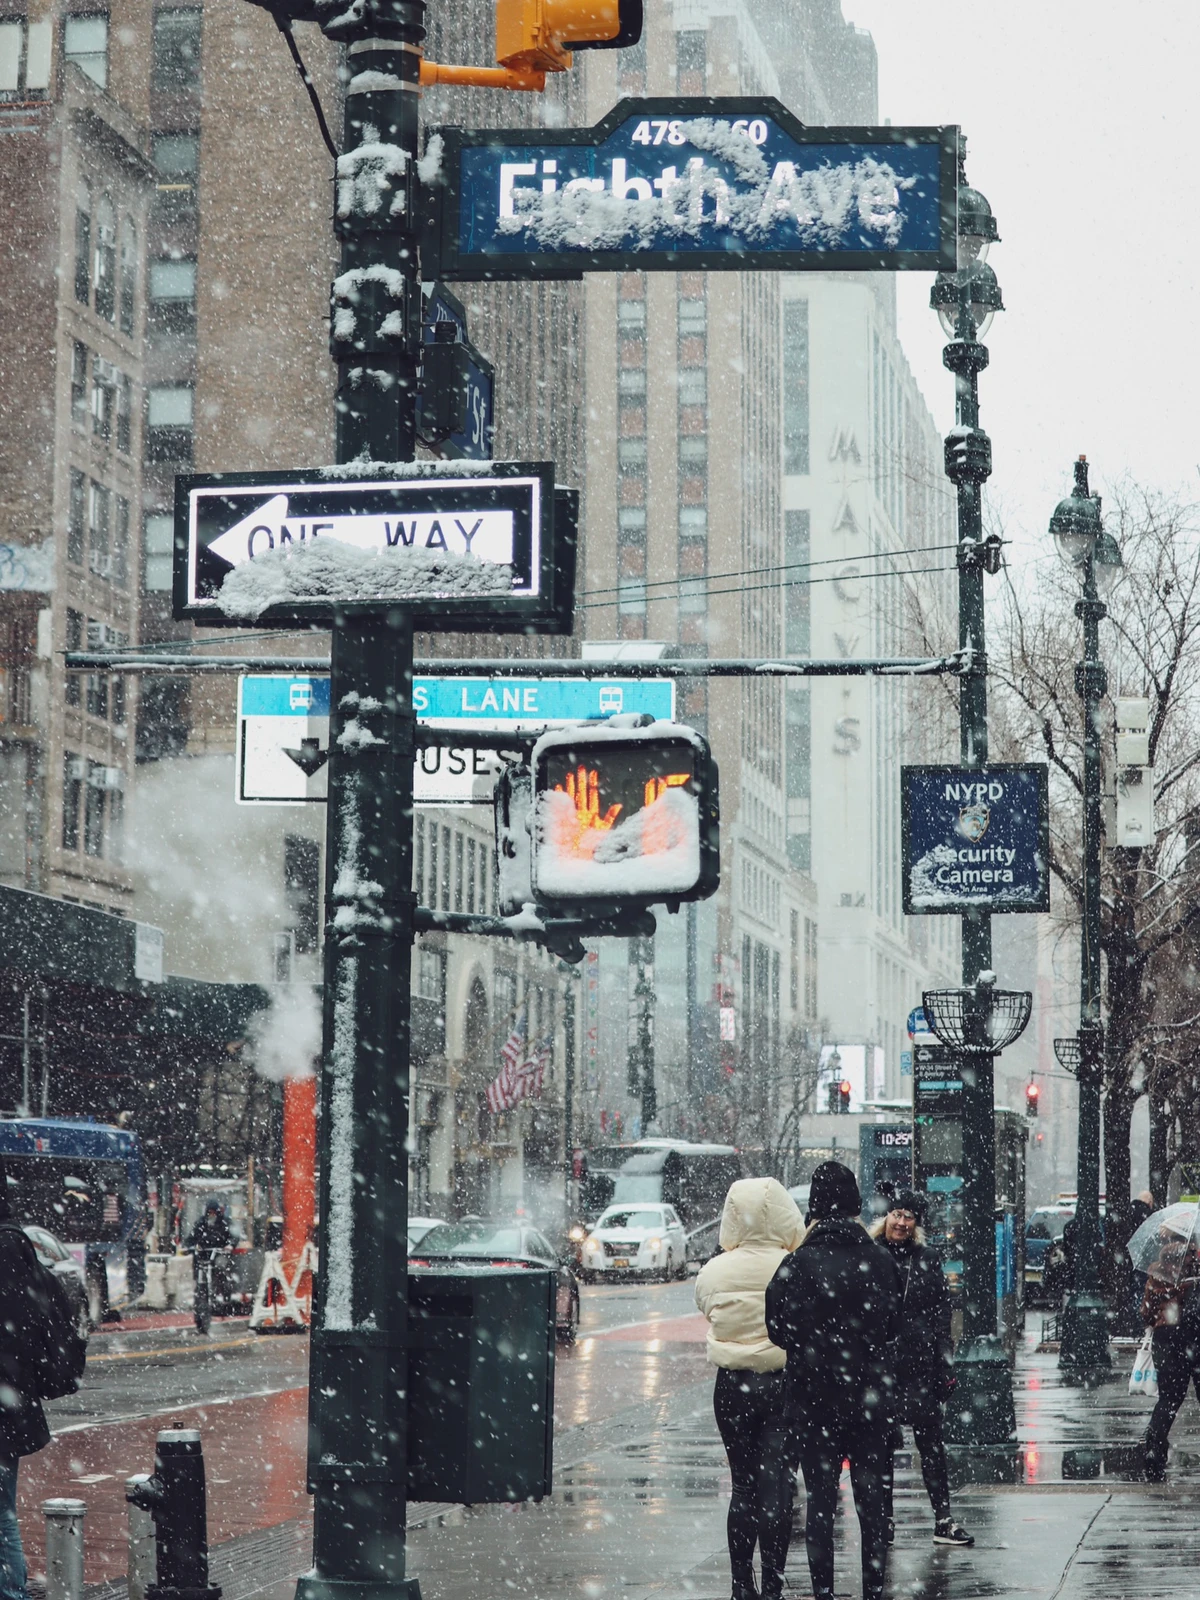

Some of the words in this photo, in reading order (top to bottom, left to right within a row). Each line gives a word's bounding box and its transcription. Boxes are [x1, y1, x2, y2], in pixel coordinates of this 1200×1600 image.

[383, 518, 484, 553] WAY
[461, 687, 539, 712] LANE
[945, 783, 1004, 801] NYPD
[937, 866, 1014, 884] Camera
